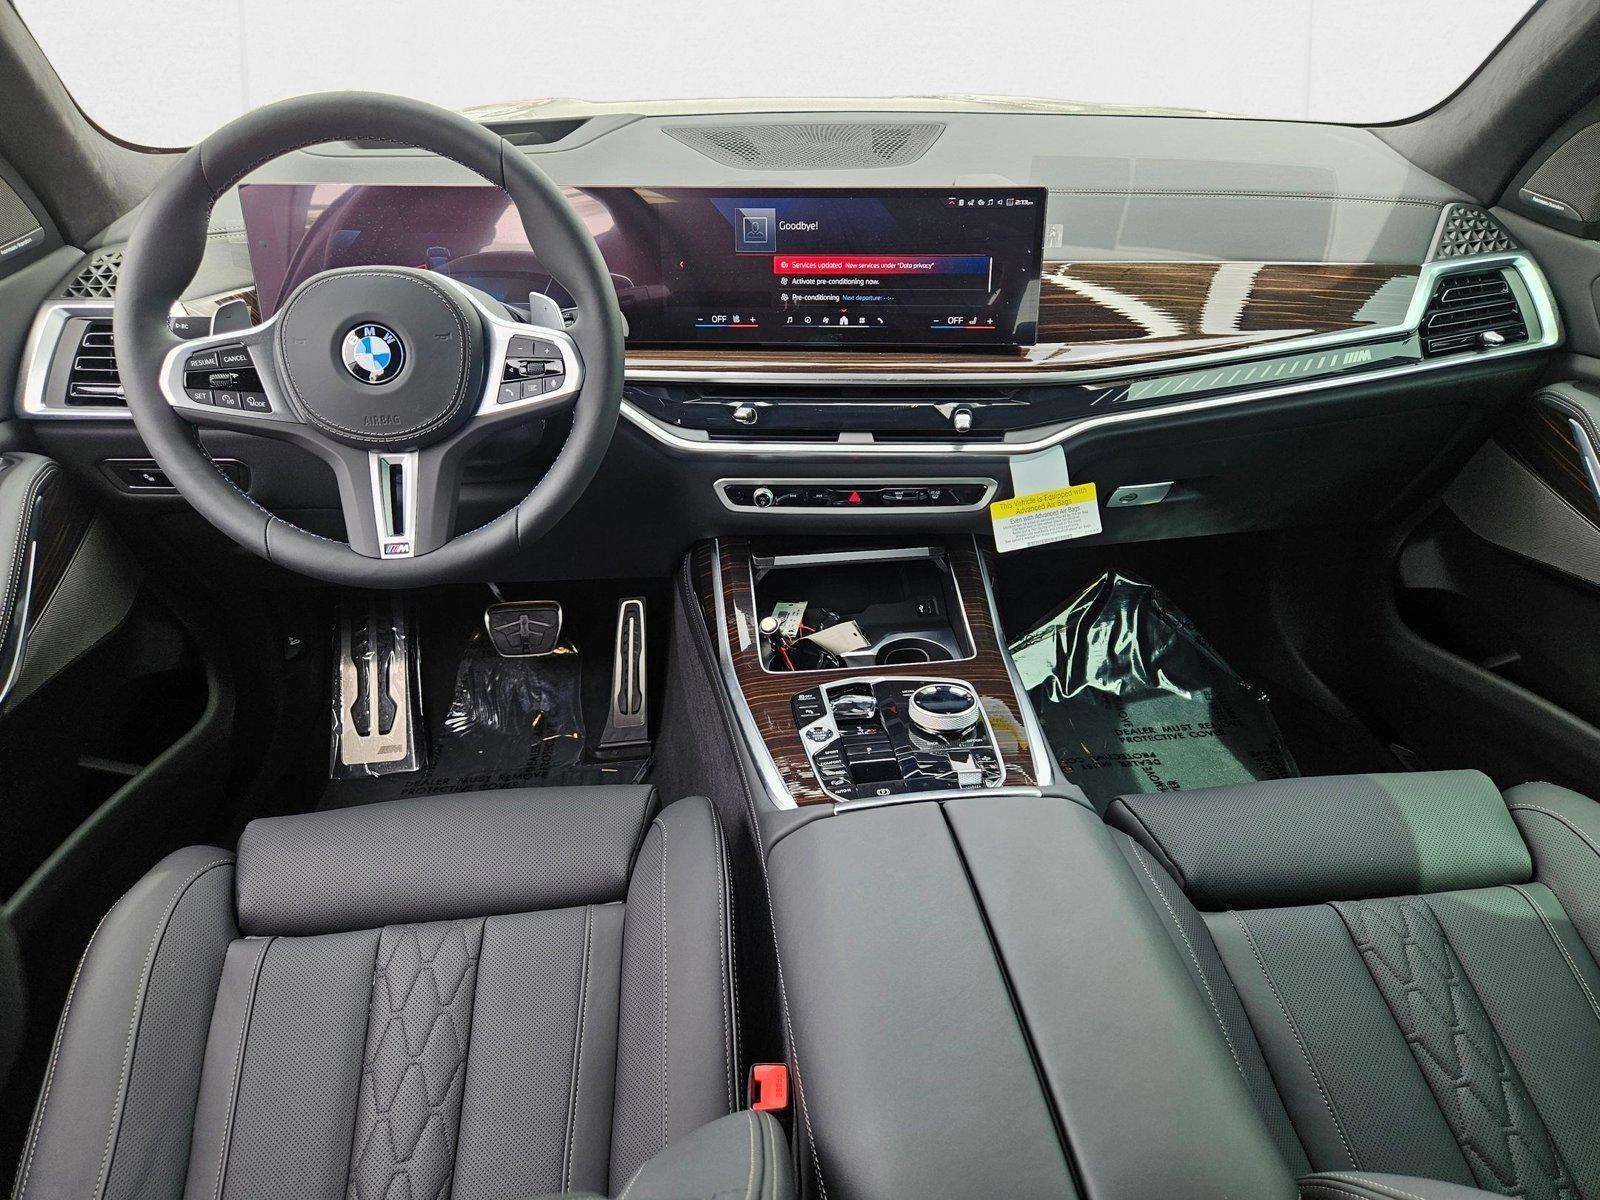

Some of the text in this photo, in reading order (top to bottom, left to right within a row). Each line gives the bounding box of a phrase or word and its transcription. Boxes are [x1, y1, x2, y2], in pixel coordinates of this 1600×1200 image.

[779, 221, 819, 231] Goodbye!
[817, 261, 842, 270] updated
[816, 278, 864, 287] pre-conditioning
[792, 293, 840, 302] Pre-conditioning
[855, 294, 882, 302] departure:
[711, 315, 727, 323] OFF
[947, 316, 964, 325] OFF
[190, 358, 216, 367] RESUME
[223, 354, 248, 363] CANCEL
[249, 400, 266, 408] MODE
[364, 415, 401, 427] AIRBAG
[1000, 502, 1013, 510] This
[1013, 498, 1036, 508] Vehicle
[1044, 490, 1073, 502] Equipped
[1074, 487, 1088, 495] with
[1015, 498, 1073, 515] Advanced Air Bags
[1010, 516, 1023, 525] Even
[1023, 514, 1035, 522] with
[1034, 509, 1059, 520] Advanced
[1059, 507, 1068, 515] Air
[1067, 506, 1081, 515] Bags
[1114, 726, 1156, 737] DEALER
[1162, 723, 1193, 734] MUST
[1119, 728, 1227, 744] PROTECTIVE COVER
[405, 770, 549, 788] DEALER MUST REMOVE
[399, 784, 474, 796] PROTECTIVE
